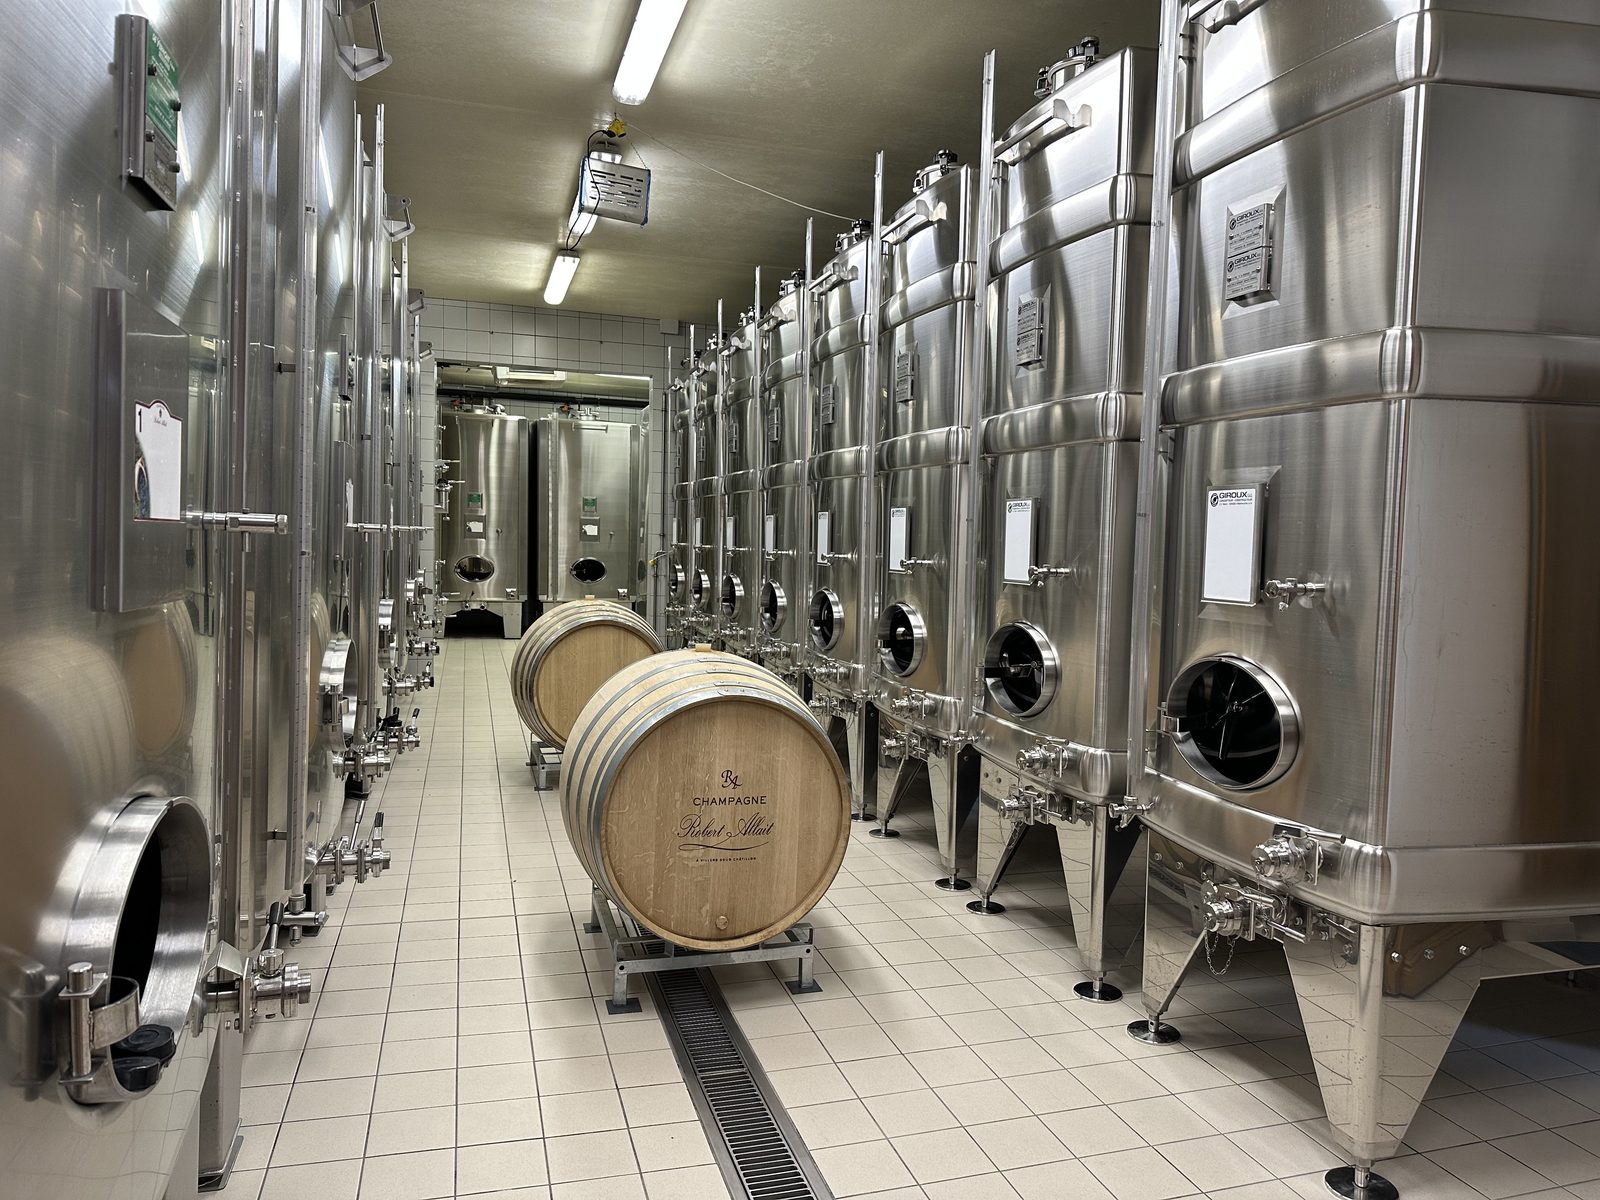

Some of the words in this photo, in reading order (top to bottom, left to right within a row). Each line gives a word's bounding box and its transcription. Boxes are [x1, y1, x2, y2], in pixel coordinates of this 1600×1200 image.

[1236, 208, 1260, 222] GIROUX
[1234, 251, 1257, 265] GIROUX
[1219, 491, 1247, 499] GIROUX
[692, 795, 767, 807] CHAMPAGNE
[677, 813, 726, 838] Robert
[726, 811, 775, 838] Allait
